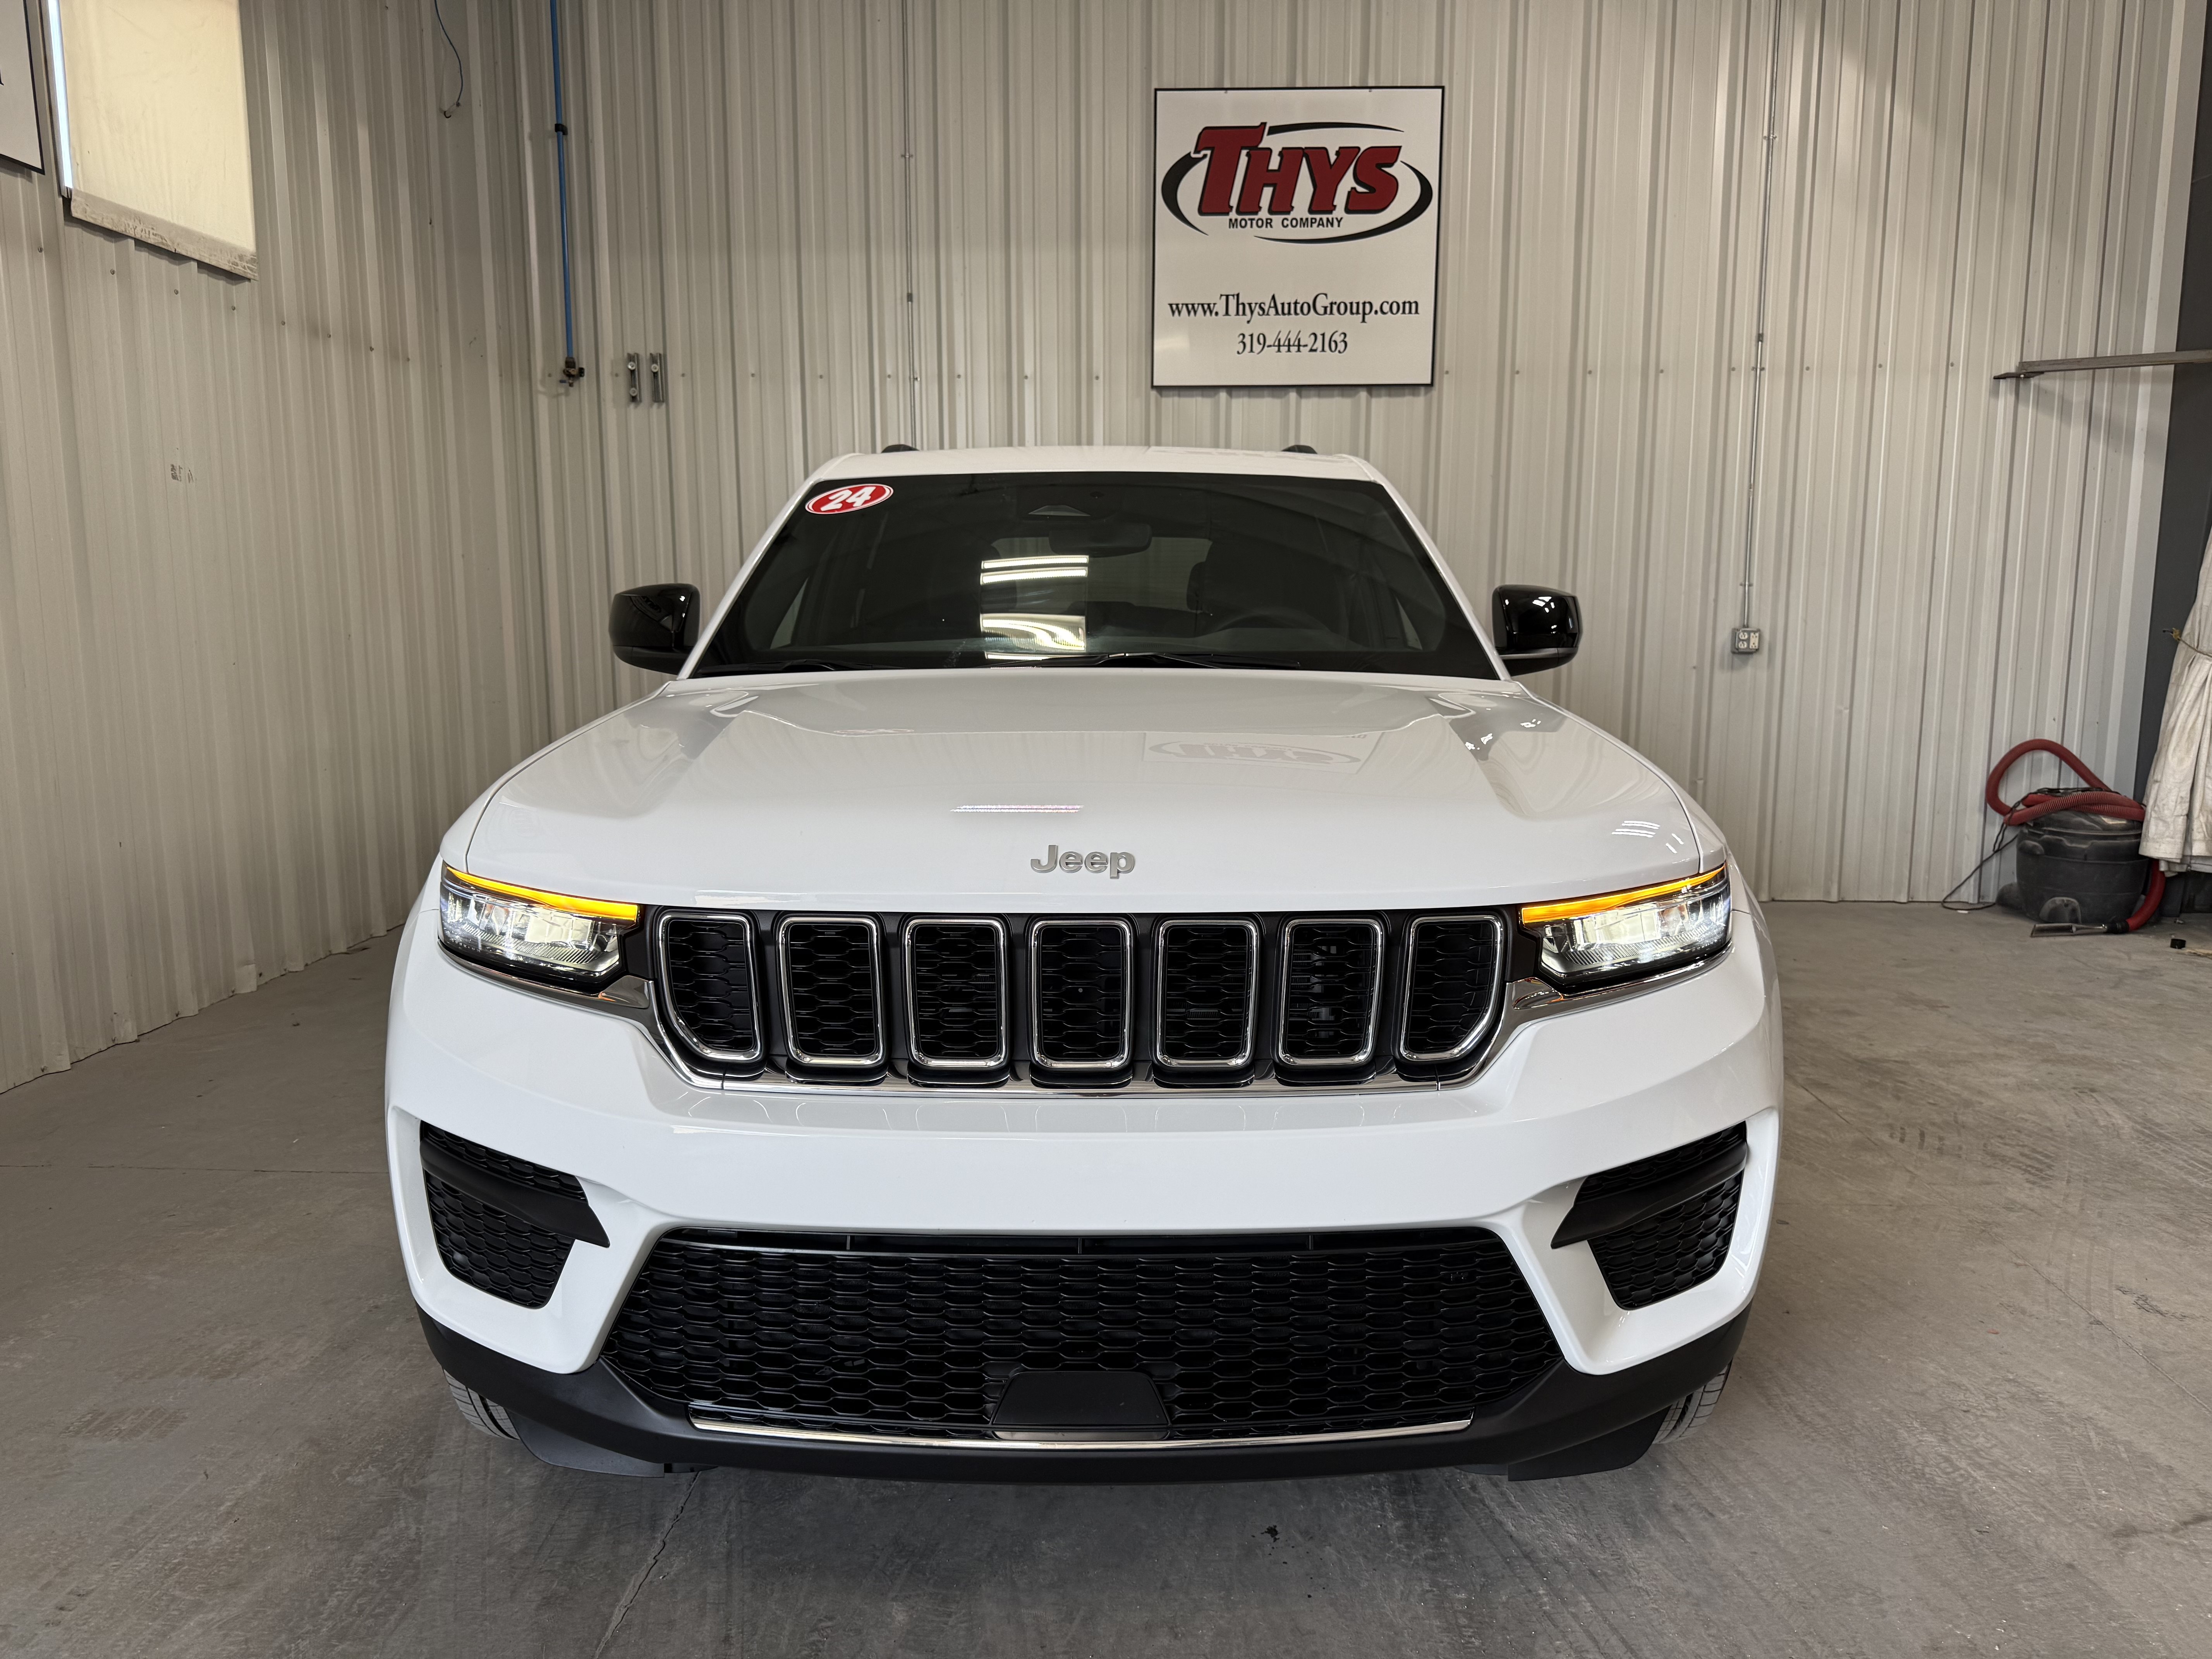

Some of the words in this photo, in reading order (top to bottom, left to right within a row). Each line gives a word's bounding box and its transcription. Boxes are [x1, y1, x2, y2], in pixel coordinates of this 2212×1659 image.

[1194, 122, 1402, 216] THYS
[1228, 218, 1273, 229] MOTOR
[1281, 217, 1343, 228] COMPANY
[1167, 292, 1420, 324] www.ThysAutoGroup.com
[1237, 330, 1348, 355] 319-444-2163
[820, 486, 876, 512] 24
[1030, 844, 1135, 879] Jeep
